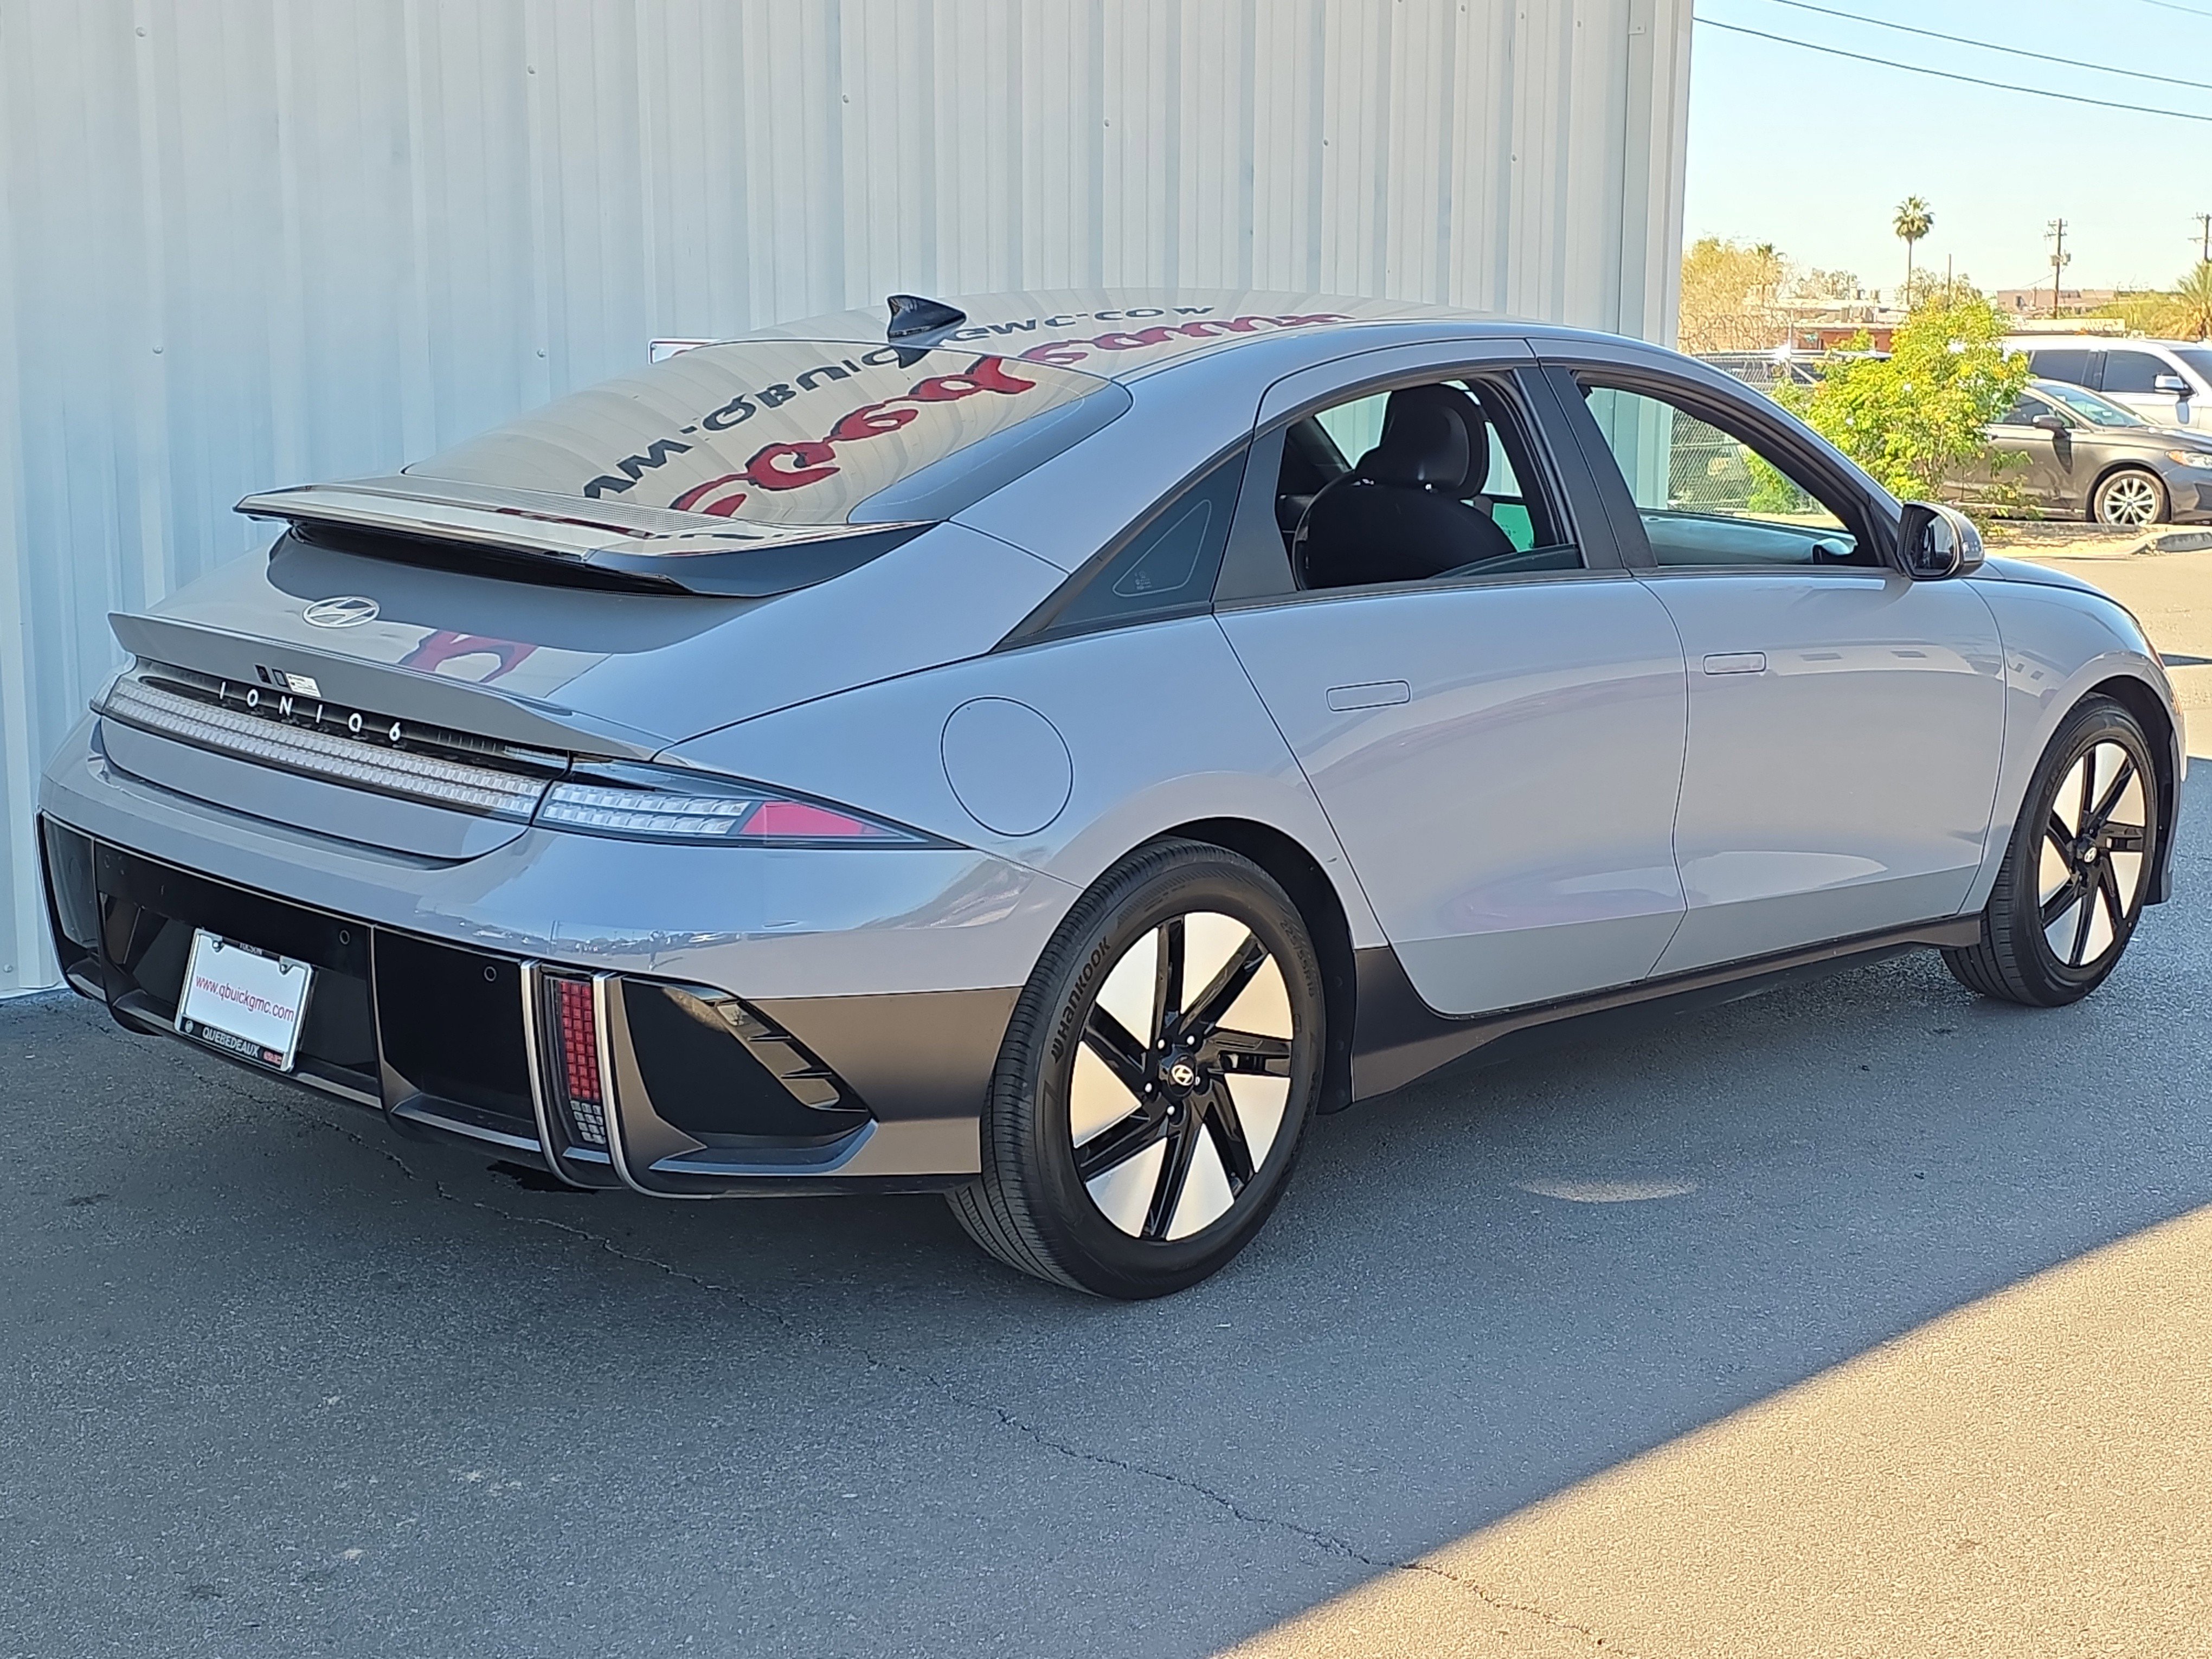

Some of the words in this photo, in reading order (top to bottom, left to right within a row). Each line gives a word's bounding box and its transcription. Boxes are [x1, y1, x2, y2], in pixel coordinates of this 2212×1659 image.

[219, 681, 363, 732] IONIQ
[389, 722, 401, 741] 6
[239, 942, 263, 955] TUCSON
[195, 975, 294, 1023] www.qbuickgmc.com
[202, 1027, 261, 1058] QUEBEDEAUX
